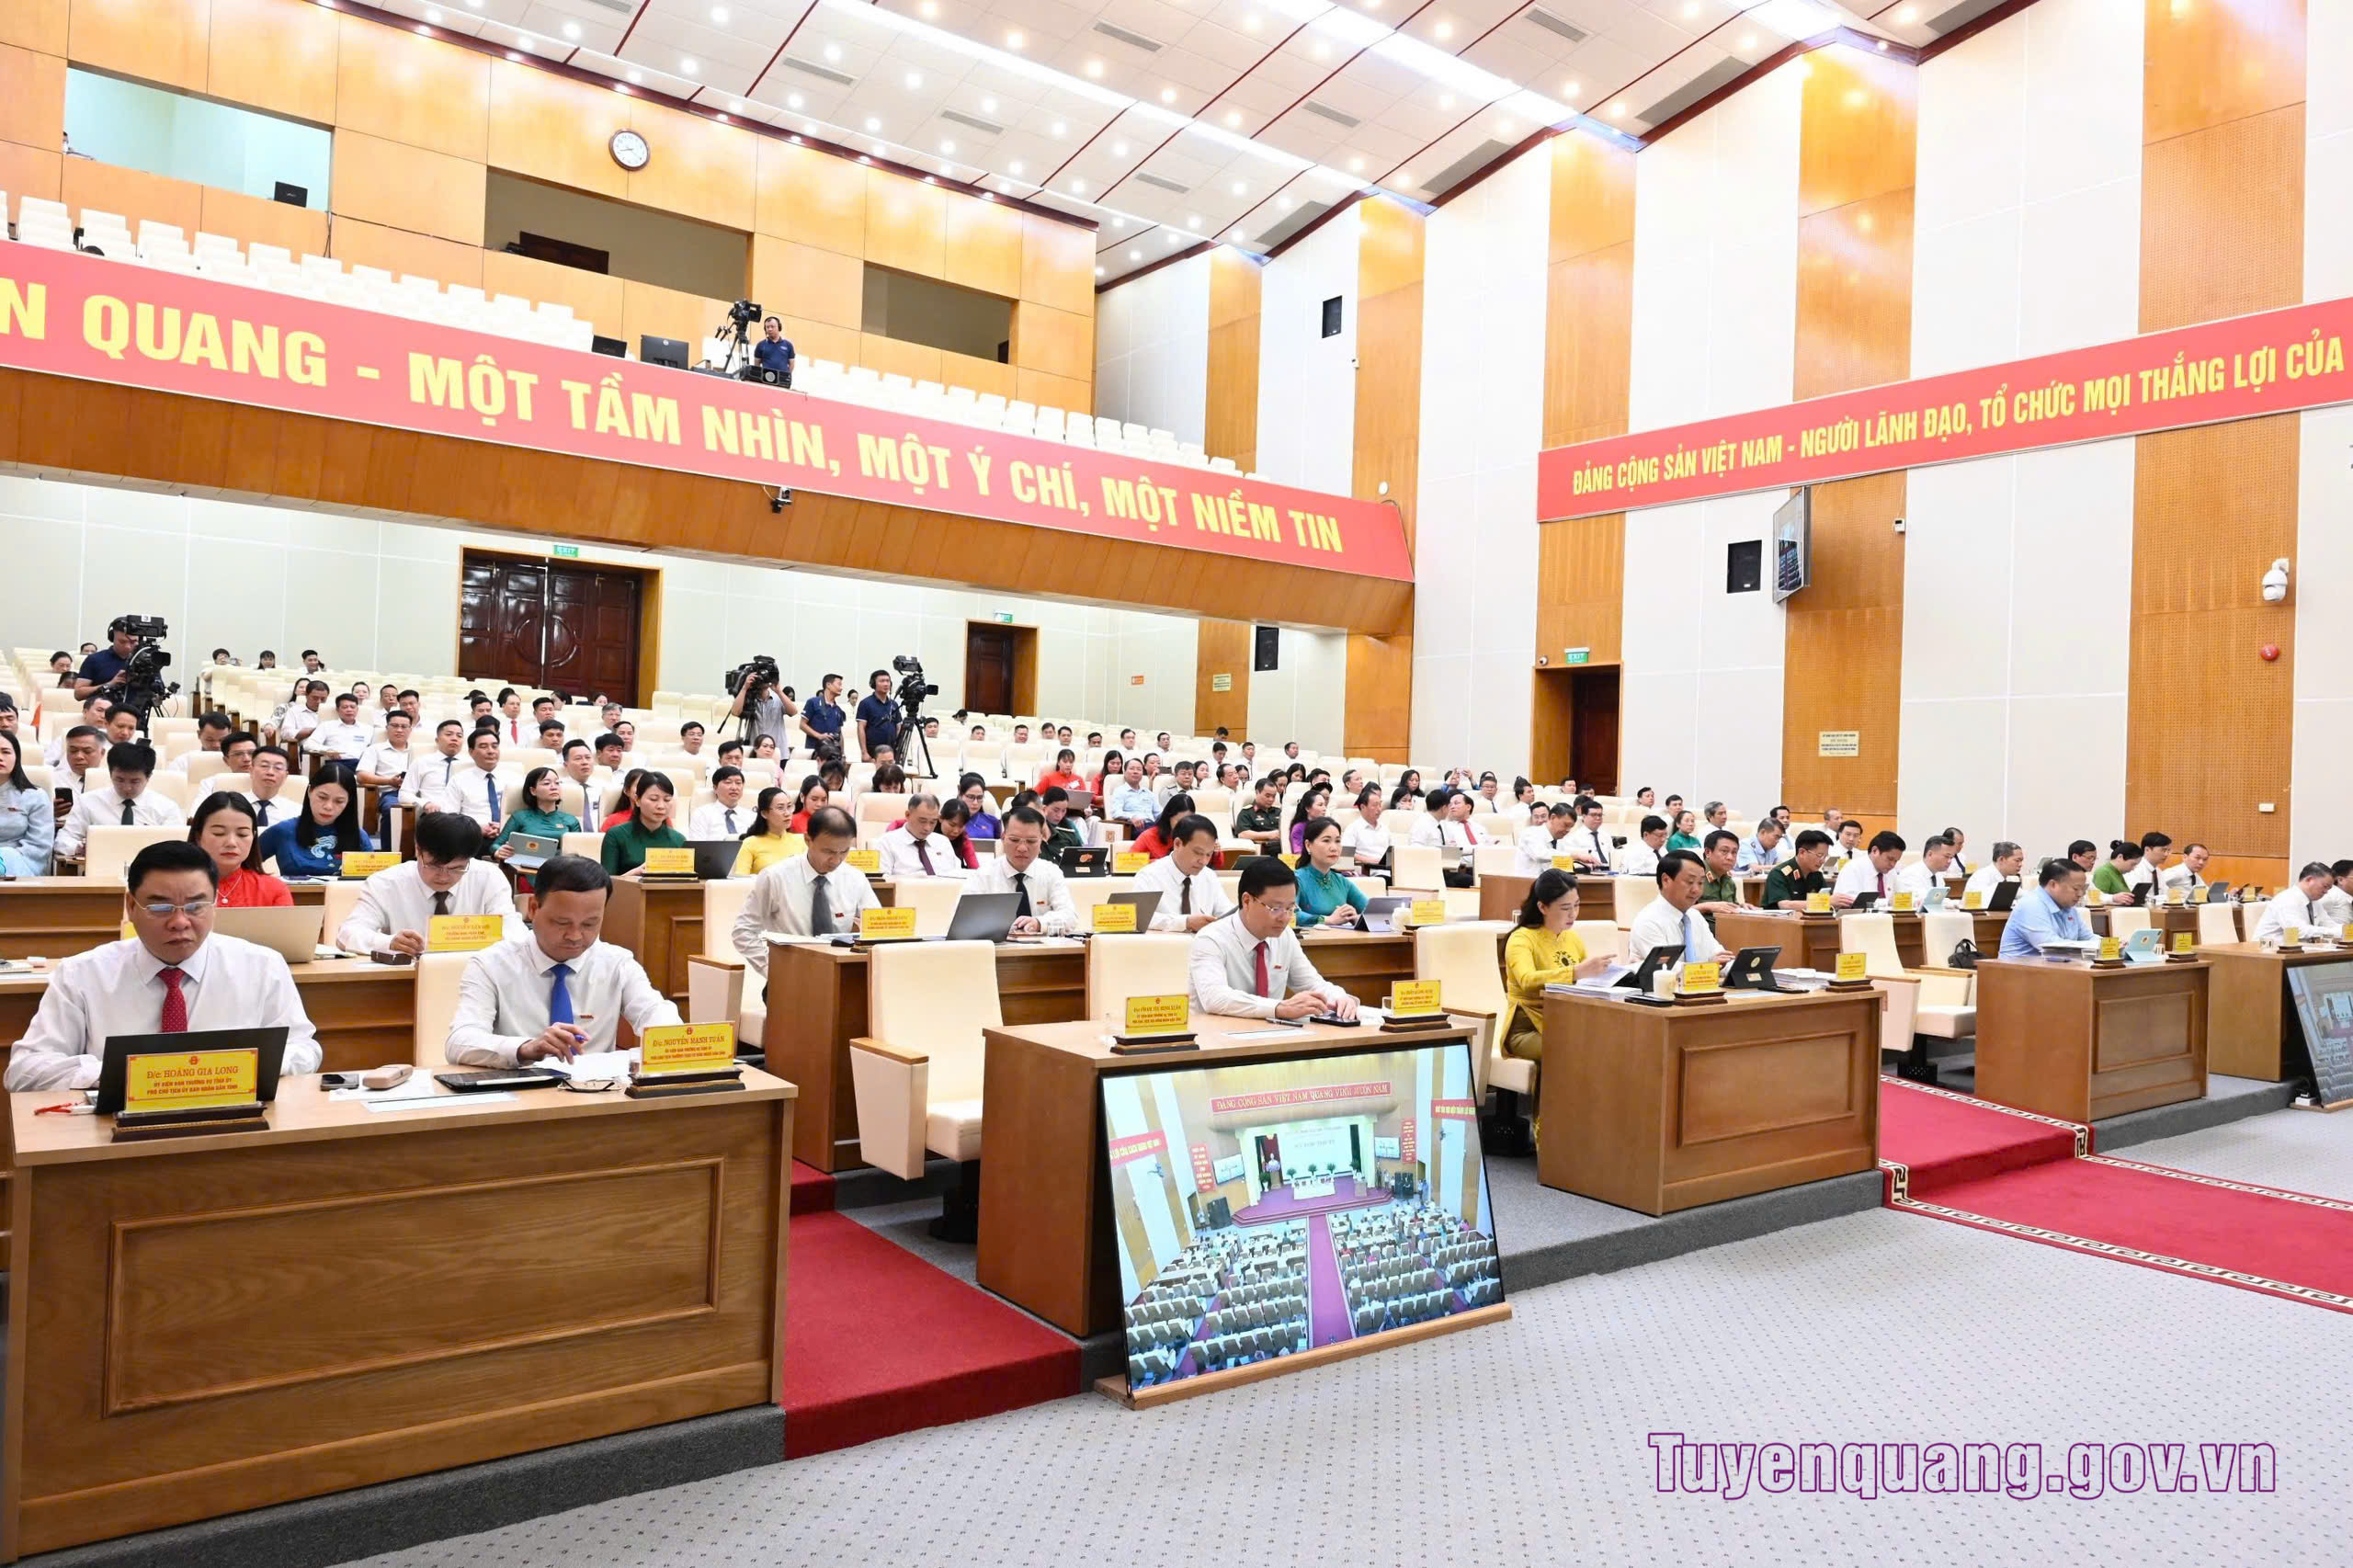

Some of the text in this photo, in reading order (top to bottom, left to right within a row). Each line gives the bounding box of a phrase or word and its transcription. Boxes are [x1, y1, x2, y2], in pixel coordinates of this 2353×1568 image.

[83, 294, 327, 387] QUANG
[408, 354, 539, 426] MỘT
[562, 371, 682, 445] TẦM
[702, 405, 841, 477] NHÌN,
[858, 426, 950, 496] MỘT
[967, 443, 992, 497] Ý
[1011, 457, 1090, 518] CHÍ,
[1102, 475, 1178, 533] MỘT
[1190, 488, 1281, 544] NIỀM
[1288, 509, 1344, 553] TIN
[1573, 460, 1613, 495] ĐẢNG
[1617, 455, 1659, 493] CỘNG
[1664, 443, 1697, 481] SẢN
[1701, 438, 1737, 478] VIỆT
[1741, 435, 1783, 468] NAM
[1801, 415, 1859, 459] NGƯỜI
[1865, 410, 1918, 449] LÃNH
[1923, 402, 1973, 443] ĐẠO,
[1980, 382, 2007, 430] TỔ
[2013, 380, 2076, 424] CHỨC
[2083, 373, 2131, 415] MỌI
[2139, 351, 2226, 403] THẮNG
[2234, 346, 2277, 393] LỢI
[2285, 327, 2346, 380] CỦA
[198, 1067, 213, 1076] GIA
[215, 1065, 239, 1074] LONG
